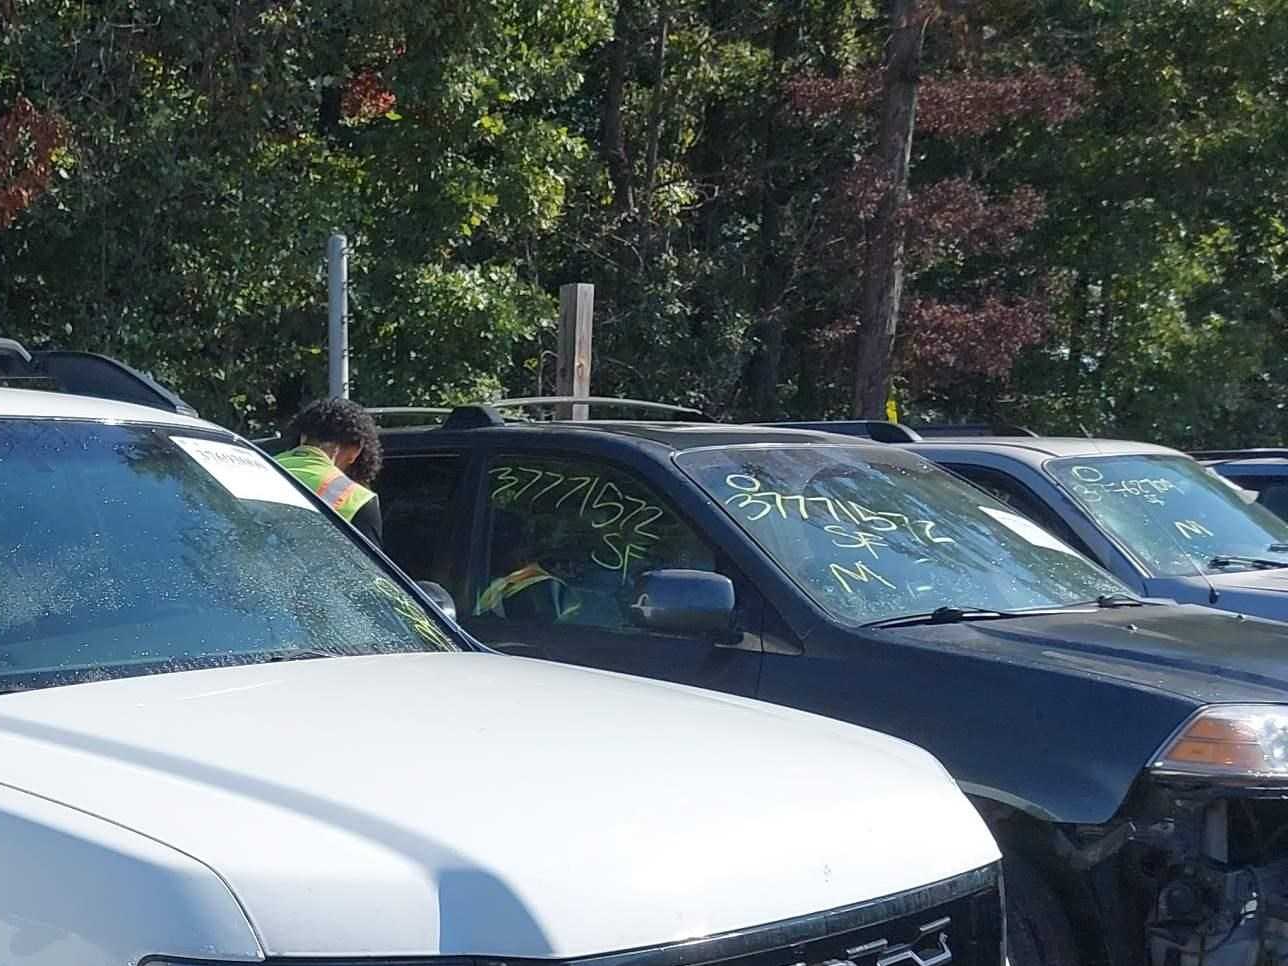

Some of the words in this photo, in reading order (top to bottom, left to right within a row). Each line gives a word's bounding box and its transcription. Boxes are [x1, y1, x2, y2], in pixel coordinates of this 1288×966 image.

[487, 466, 664, 541] 37771572
[724, 491, 956, 546] 37771572
[591, 532, 648, 586] SF
[829, 560, 897, 593] M
